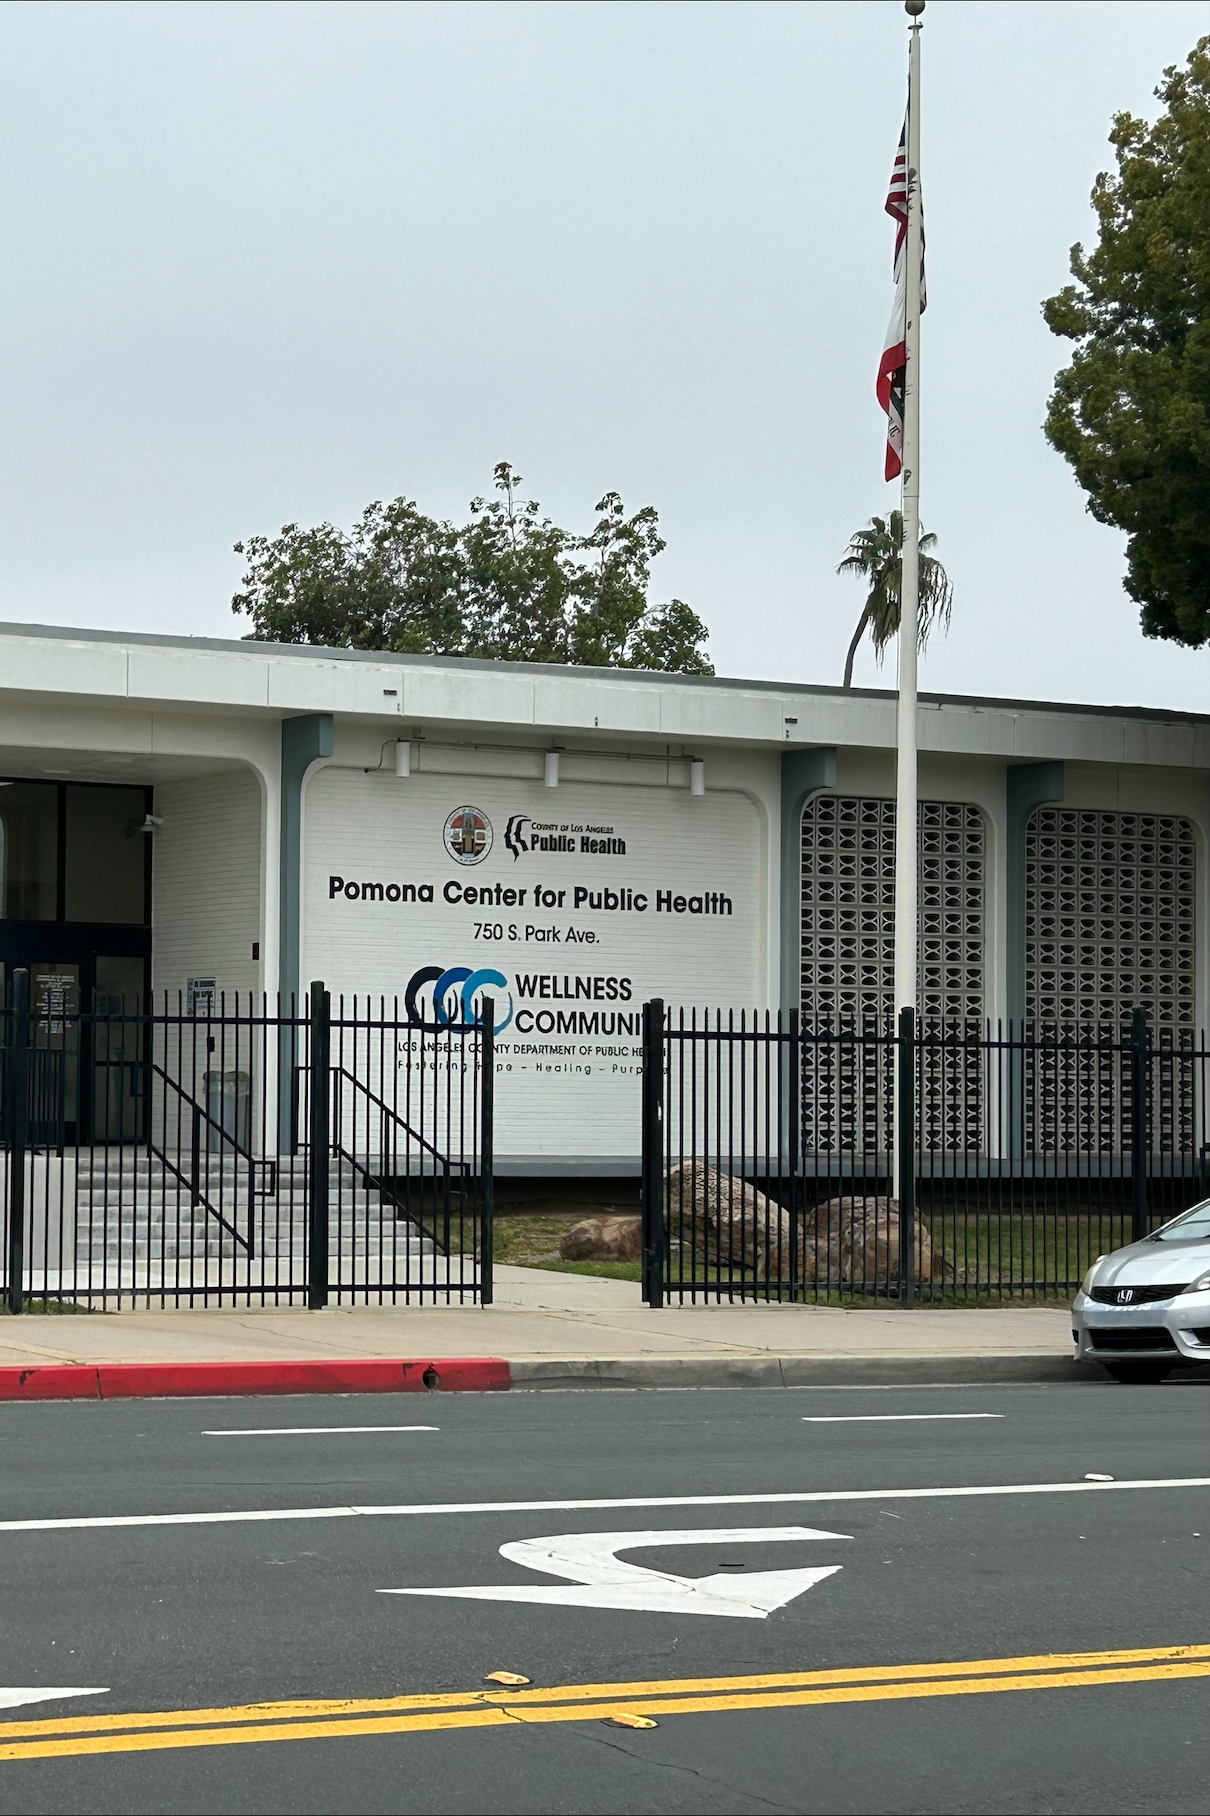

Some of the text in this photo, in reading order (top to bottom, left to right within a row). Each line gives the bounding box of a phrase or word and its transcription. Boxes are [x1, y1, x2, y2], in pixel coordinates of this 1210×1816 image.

[531, 833, 626, 855] Public Health
[329, 876, 732, 915] Pomona Center for Public Health
[473, 923, 600, 944] 750 S. Park Ave.
[515, 974, 632, 1001] WELLNESS
[515, 1009, 666, 1036] COMMUNI
[398, 1041, 417, 1052] LOS
[468, 1043, 510, 1055] CONTY
[513, 1044, 576, 1056] DEPARTMENT
[579, 1045, 592, 1056] OF
[596, 1046, 629, 1057] PUBLIC
[536, 1062, 592, 1076] Healing
